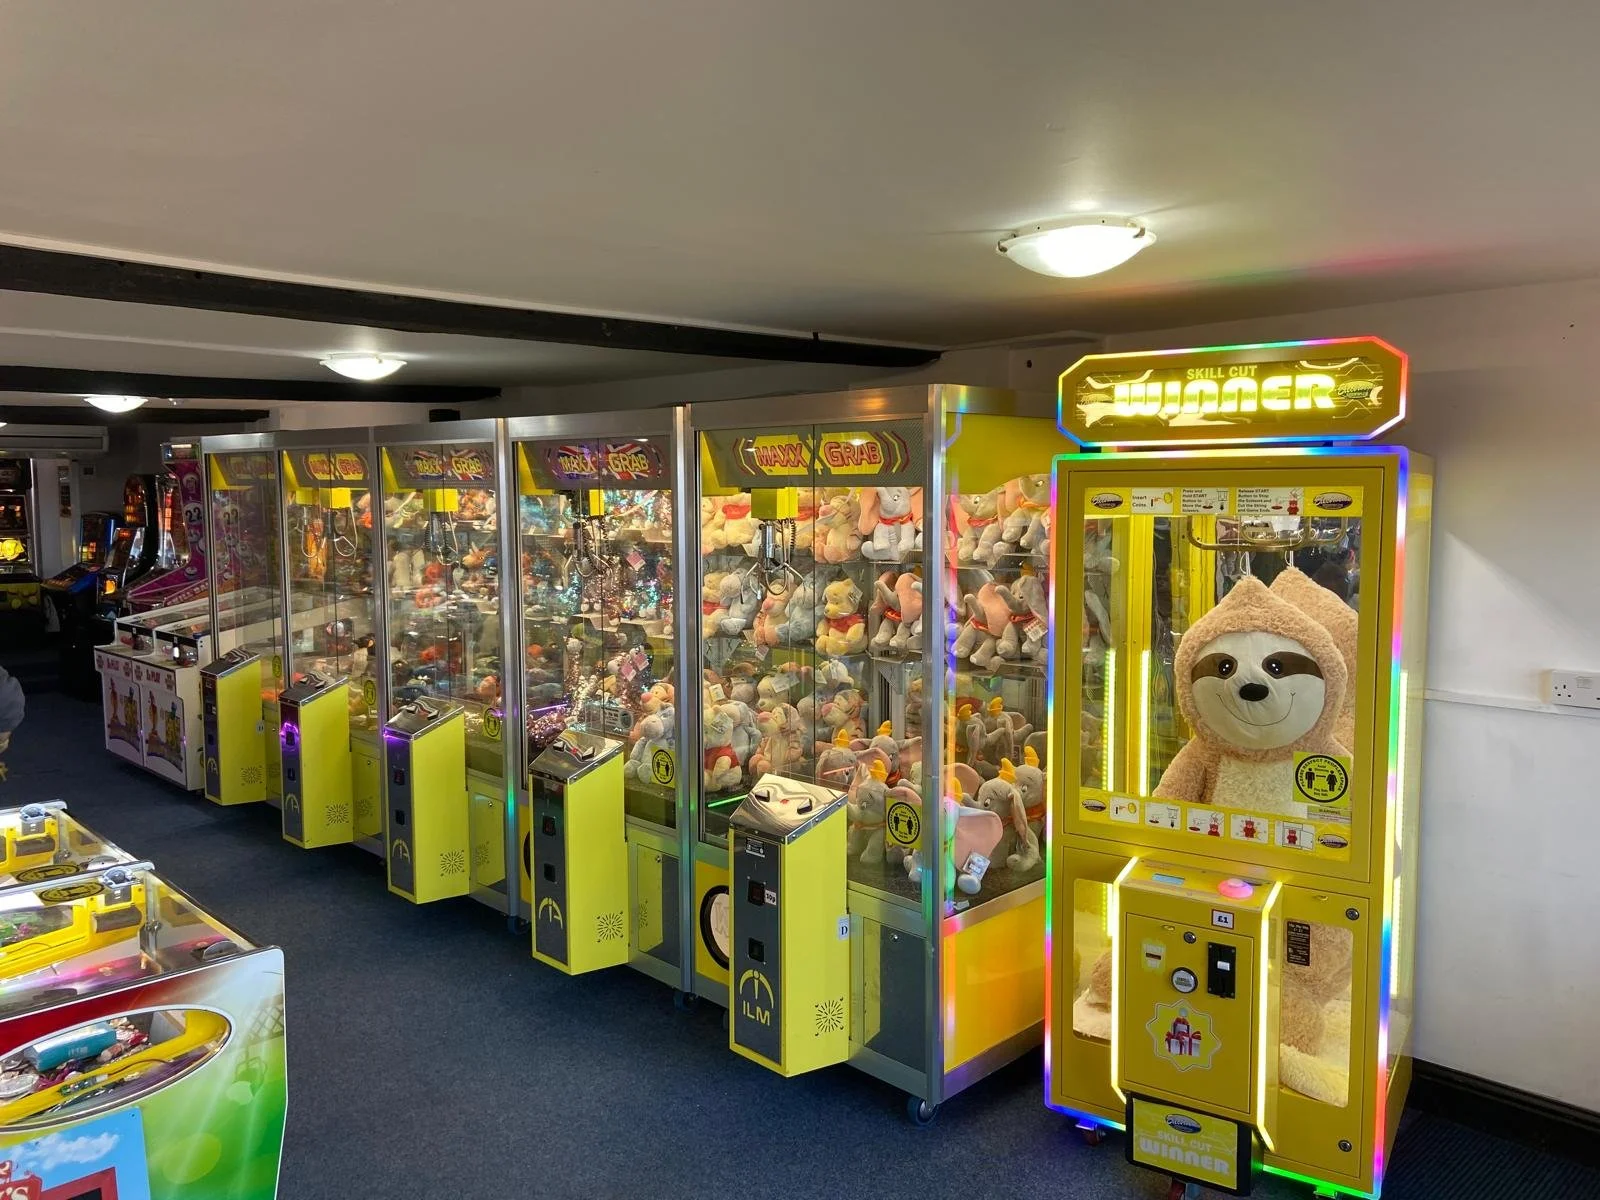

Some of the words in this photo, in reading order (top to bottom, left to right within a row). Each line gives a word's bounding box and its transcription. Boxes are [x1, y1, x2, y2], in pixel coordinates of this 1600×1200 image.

[1186, 366, 1225, 380] SKILL
[1228, 365, 1258, 377] CUT
[1113, 373, 1337, 417] WINNER
[557, 453, 595, 474] MAXX
[608, 451, 650, 472] GRAB
[755, 444, 806, 469] MAXX
[824, 441, 883, 468] GRAB
[1217, 915, 1229, 924] £1
[742, 1000, 770, 1026] ILM
[1157, 1130, 1185, 1143] SKILL
[1189, 1139, 1212, 1152] CUT
[1140, 1137, 1230, 1175] WINNER
